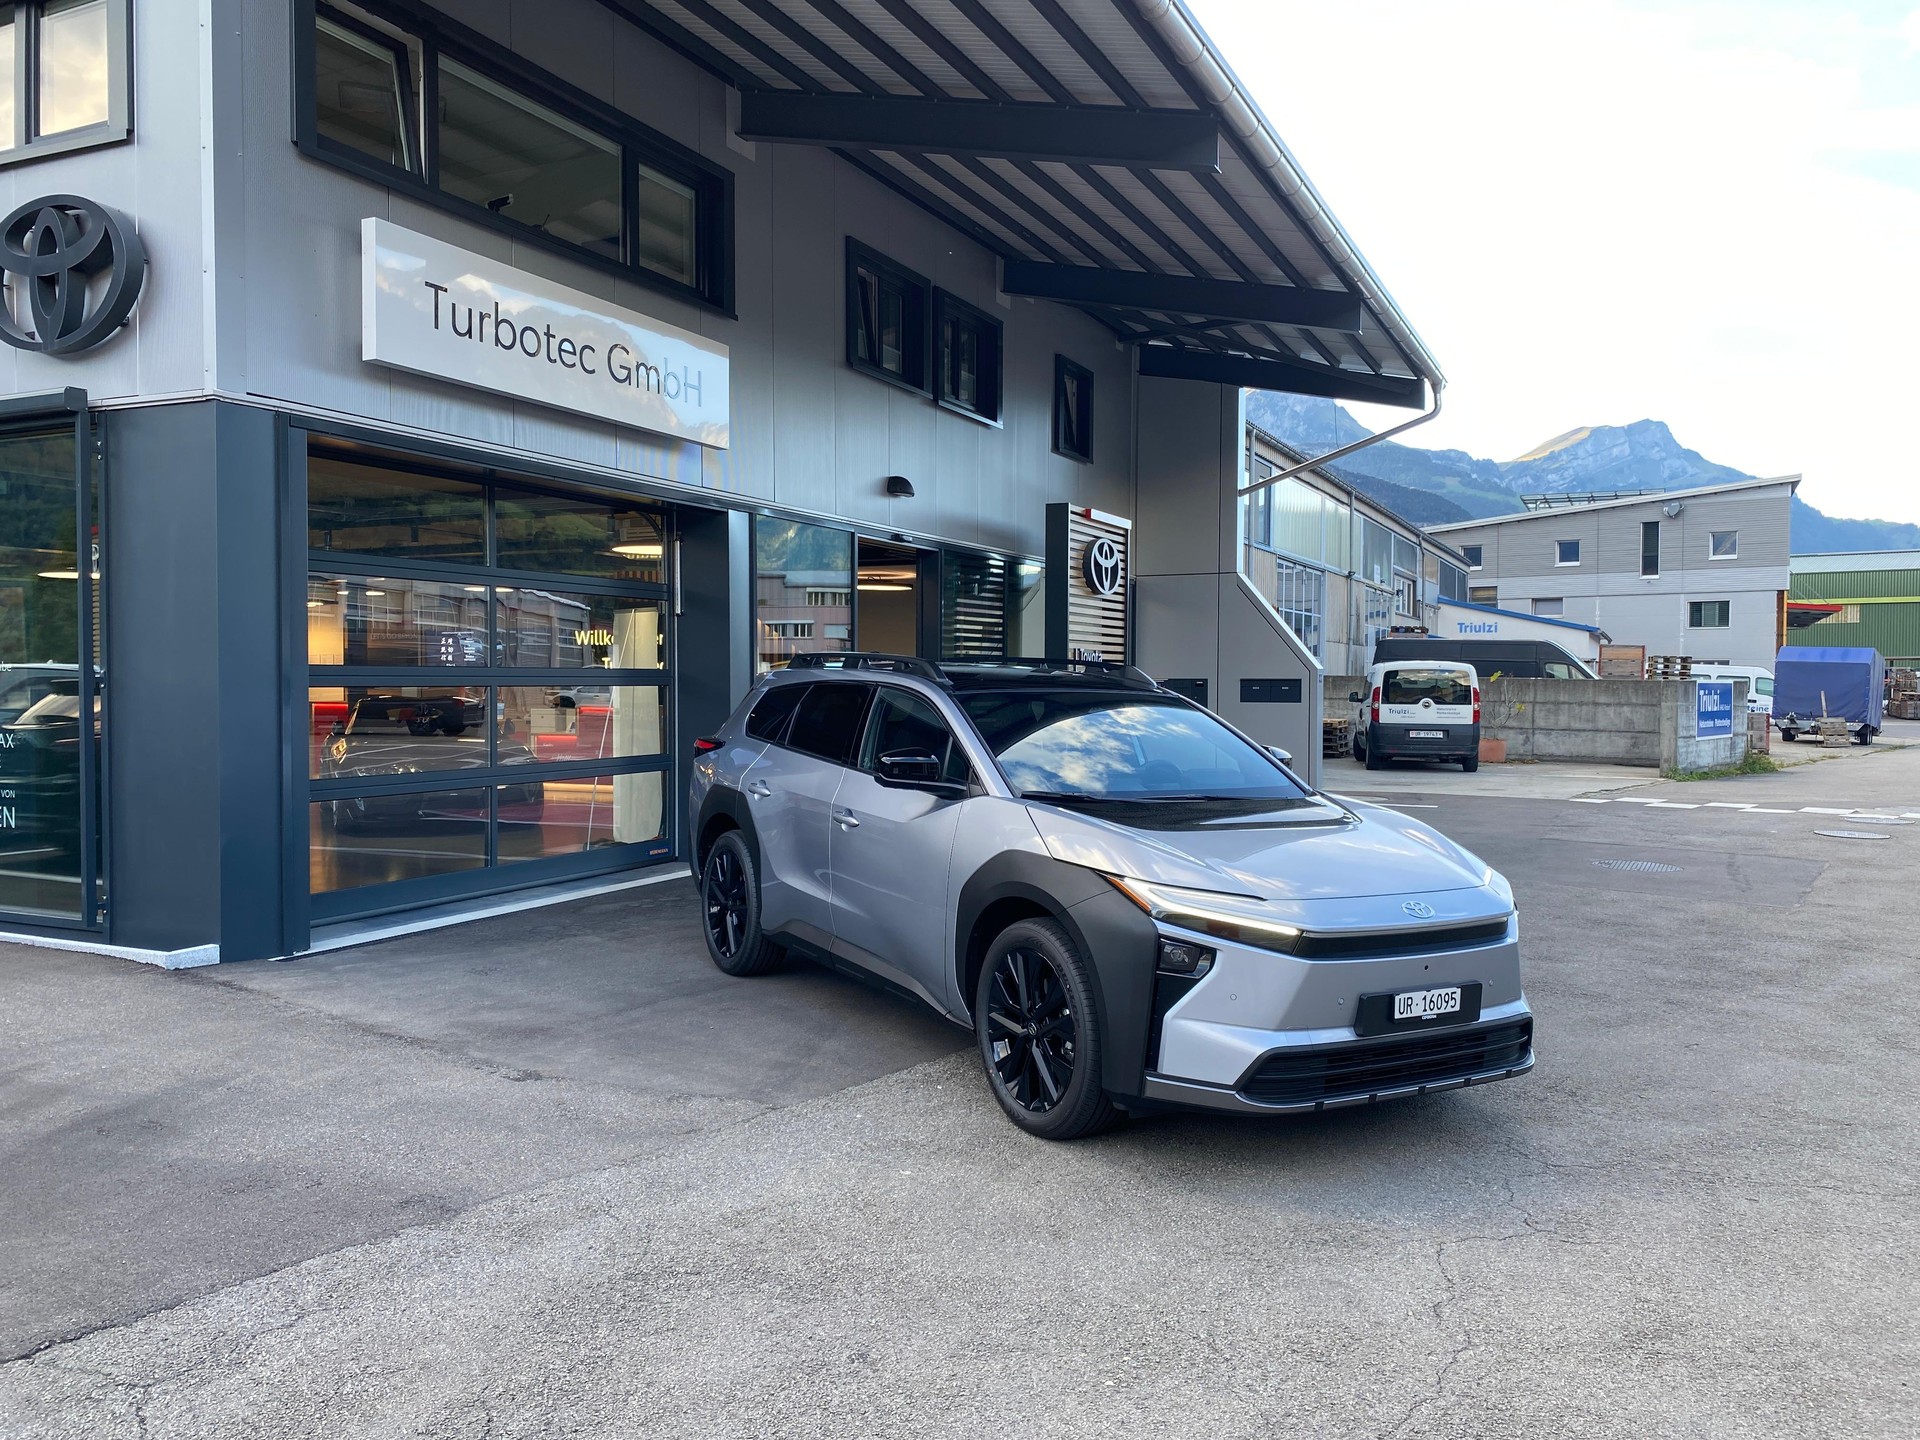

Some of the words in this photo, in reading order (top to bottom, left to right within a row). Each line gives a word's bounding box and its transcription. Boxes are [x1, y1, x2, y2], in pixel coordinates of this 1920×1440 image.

[425, 281, 596, 374] Turbotec
[607, 343, 702, 407] GmbH
[1456, 621, 1498, 634] Triulzi
[1699, 689, 1720, 713] Triulzi
[0, 789, 16, 798] VON
[1398, 996, 1413, 1015] UR
[1421, 991, 1457, 1012] 16095
